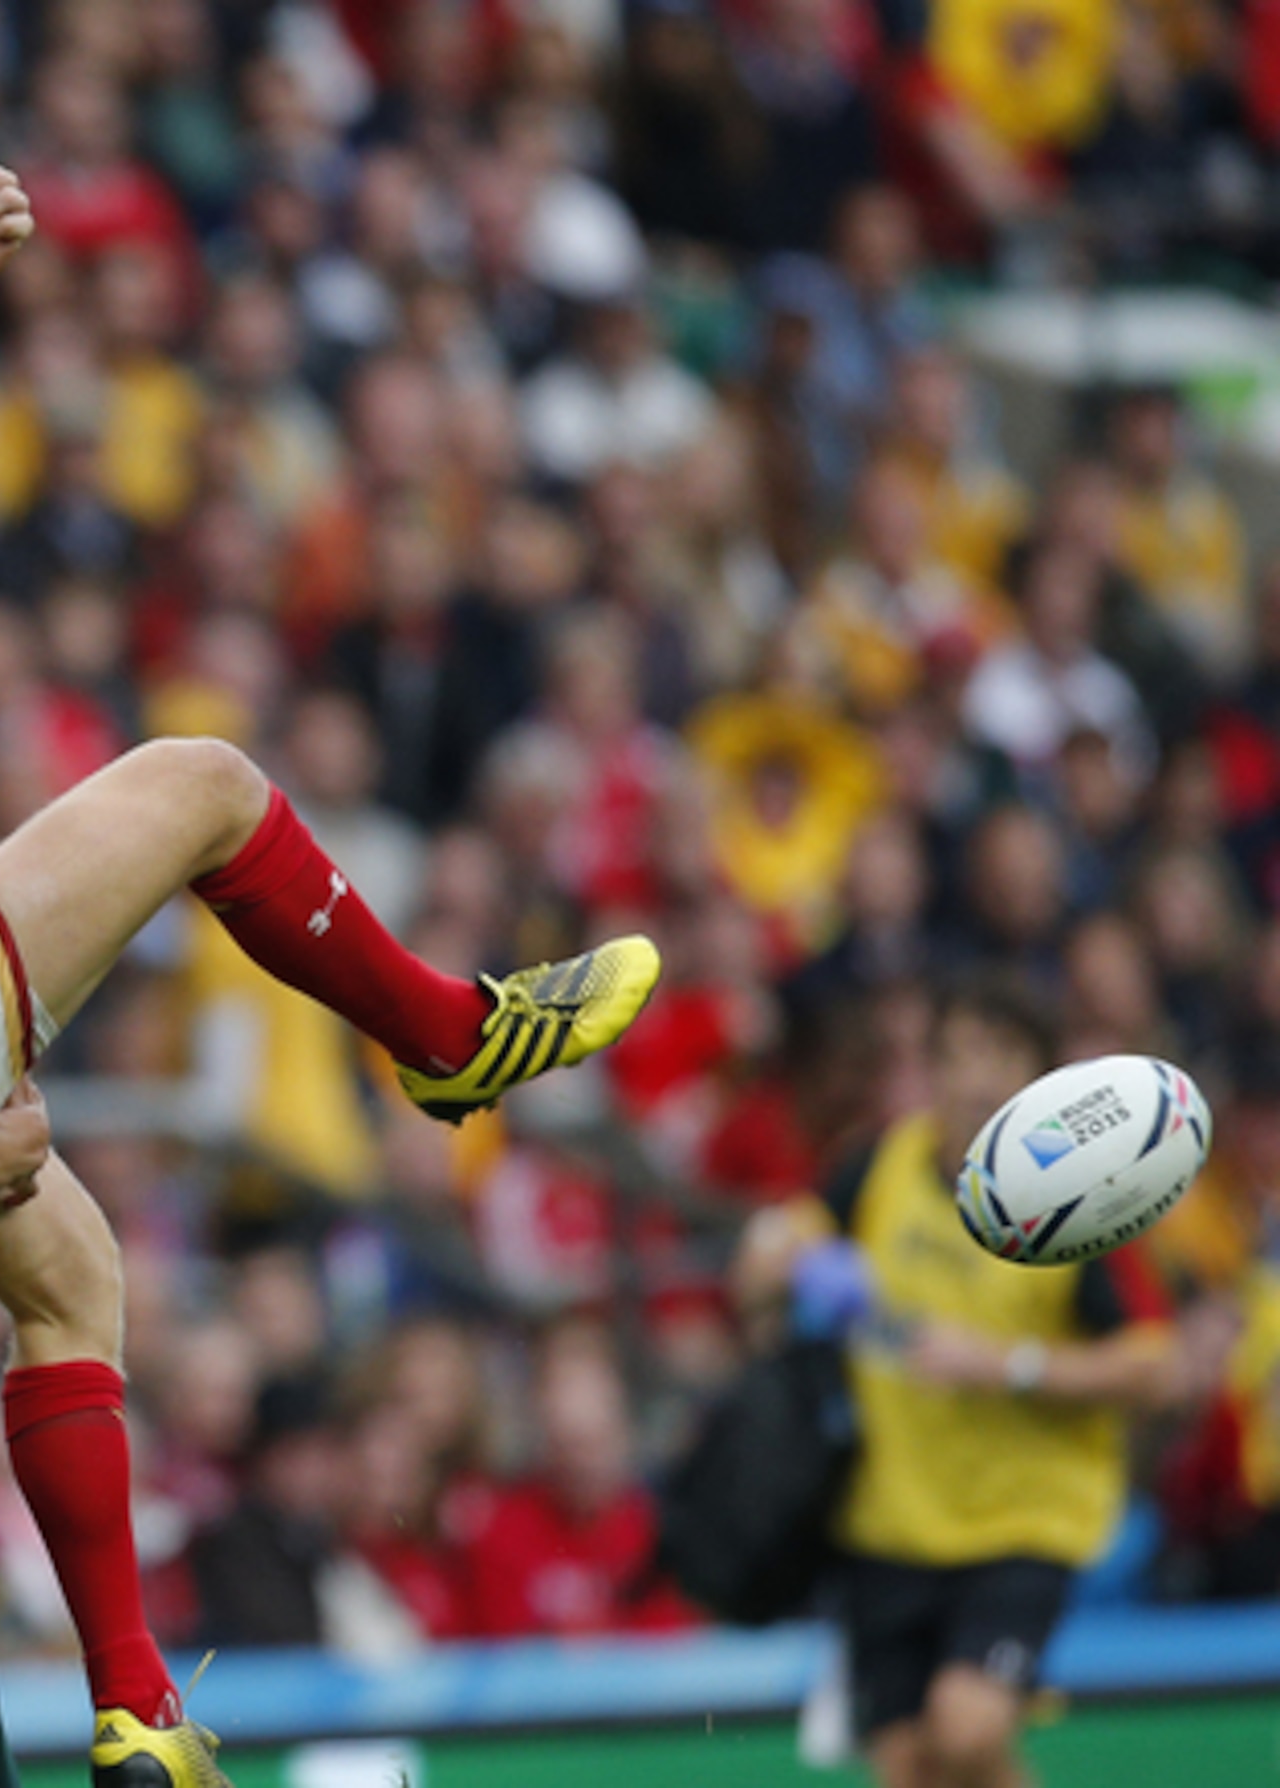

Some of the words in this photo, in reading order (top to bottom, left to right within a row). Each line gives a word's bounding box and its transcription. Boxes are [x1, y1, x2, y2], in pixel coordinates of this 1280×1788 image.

[1060, 1085, 1115, 1122] RUGBY
[1075, 1106, 1131, 1146] 2015
[1056, 1174, 1188, 1260] GILBERT
